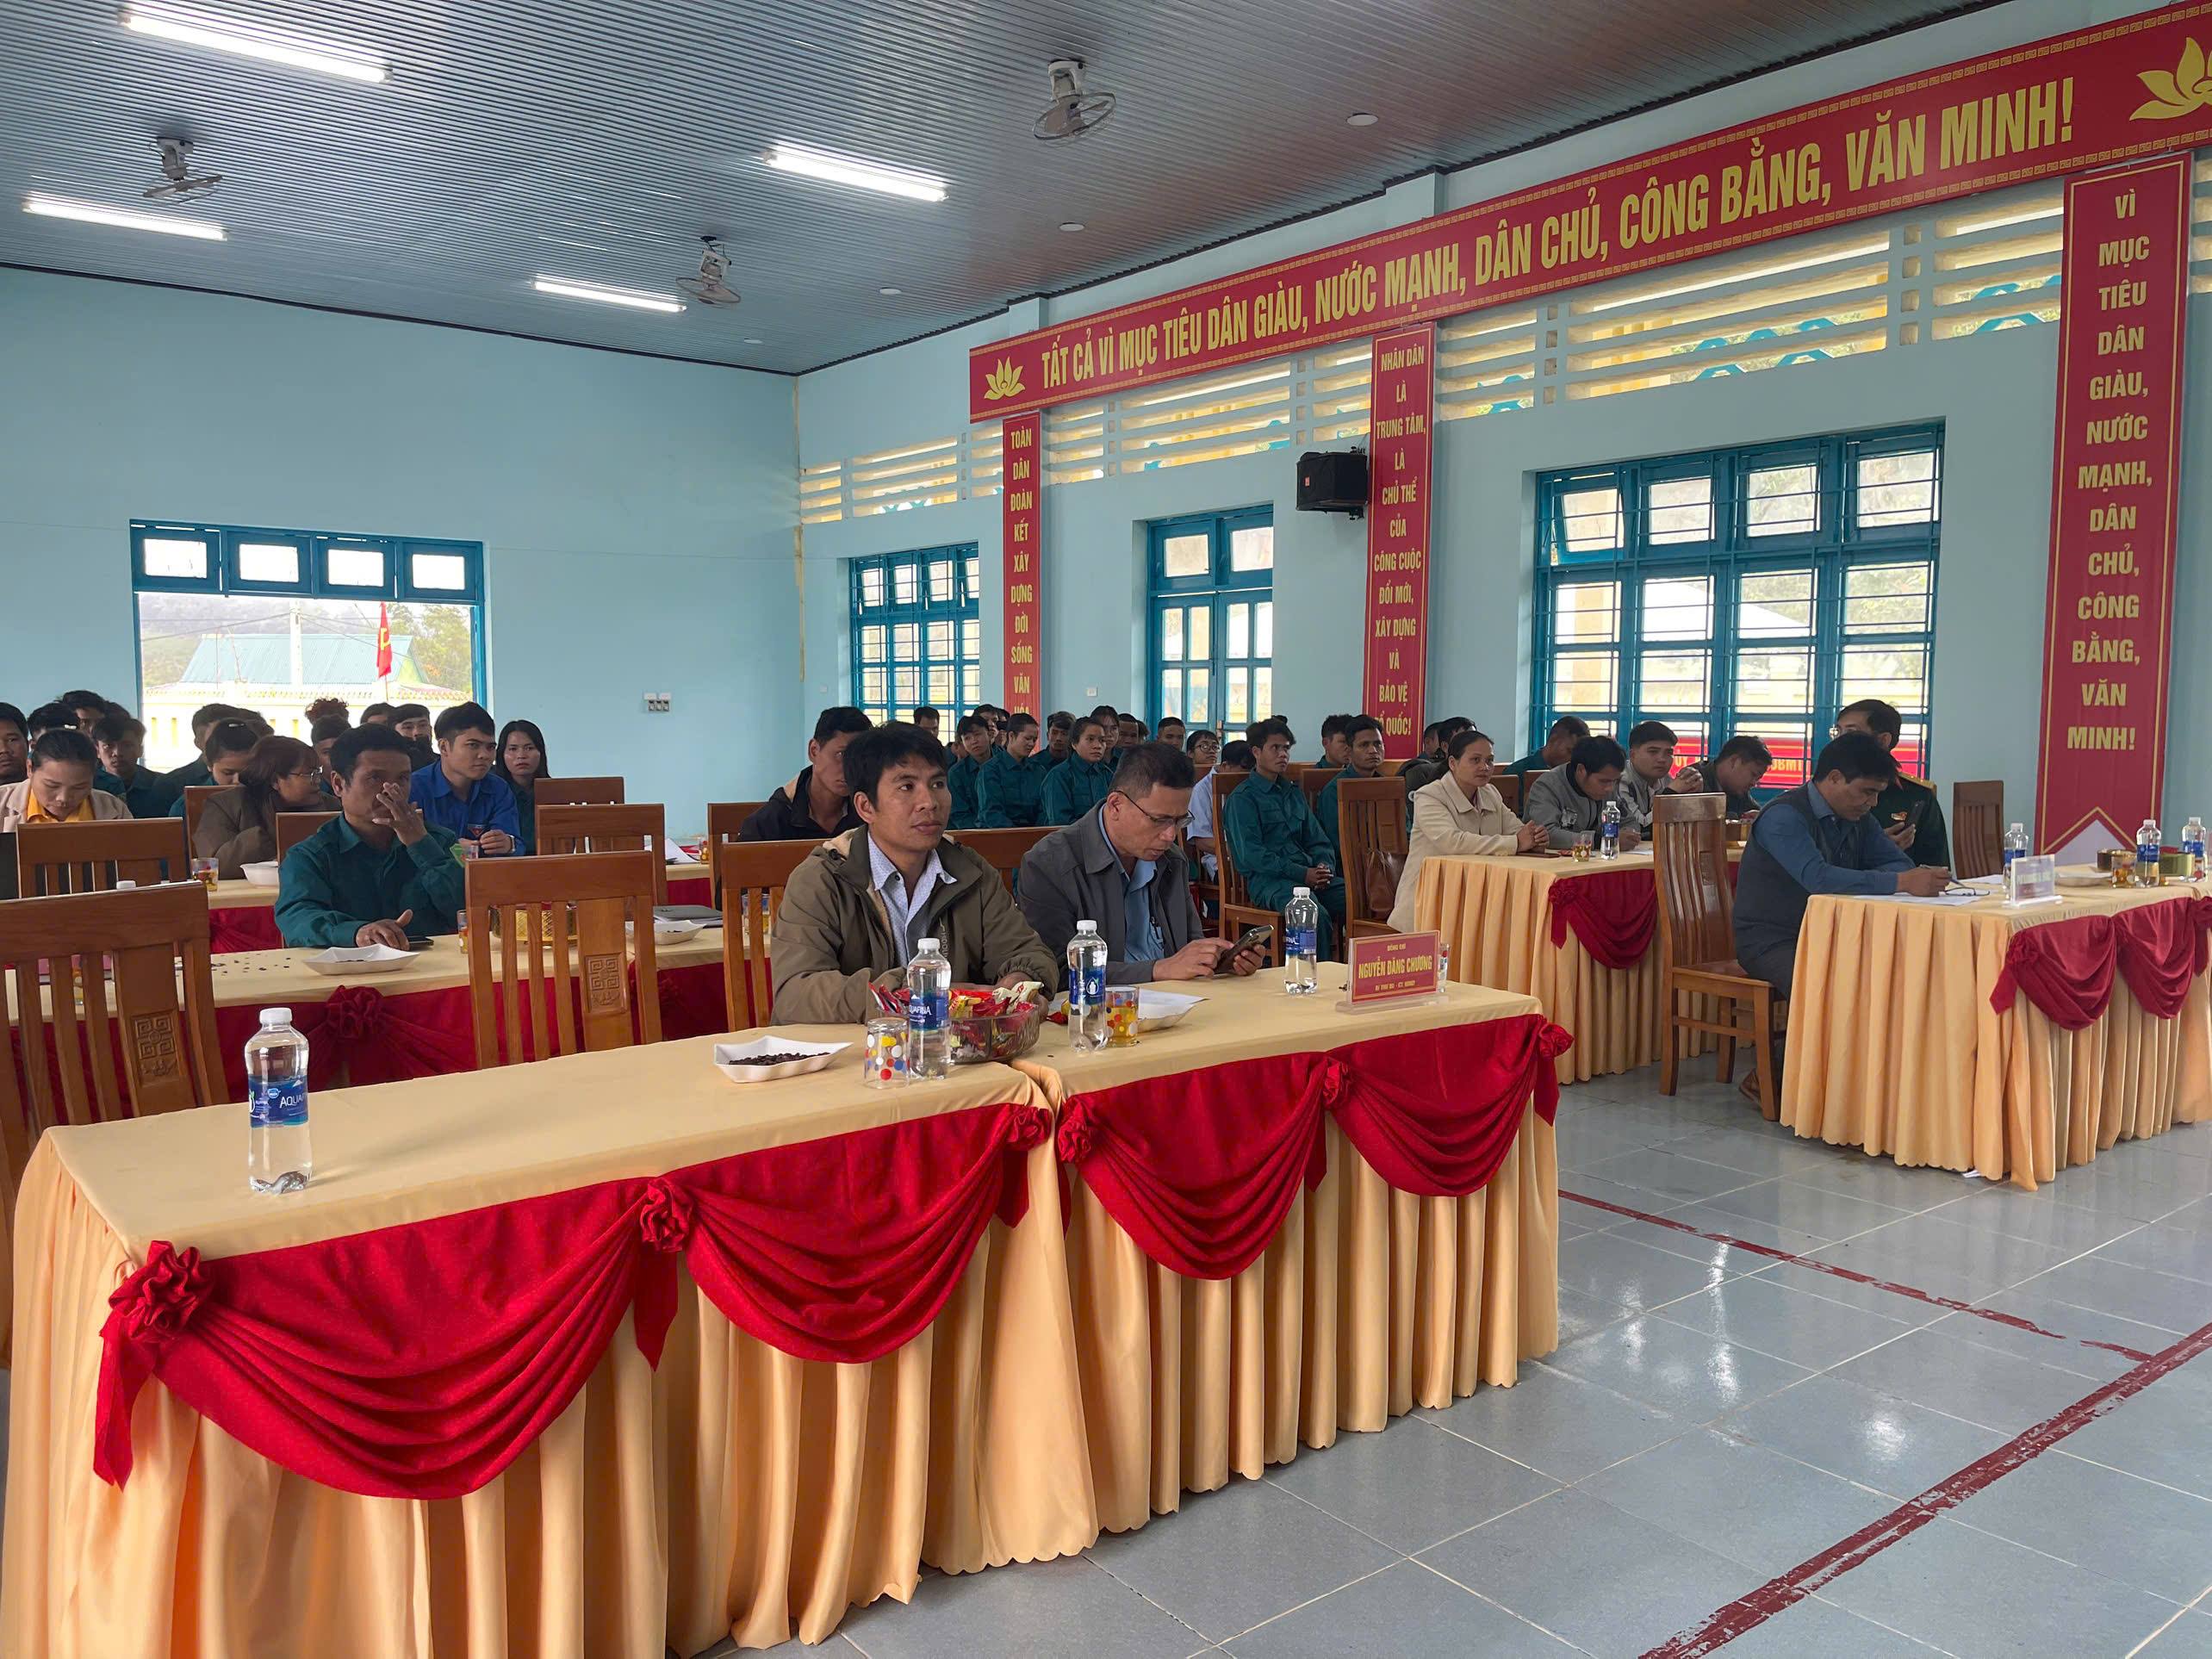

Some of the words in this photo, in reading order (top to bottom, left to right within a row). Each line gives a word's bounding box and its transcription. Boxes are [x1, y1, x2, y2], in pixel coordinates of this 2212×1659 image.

[2114, 188, 2136, 220] VÌ
[1041, 334, 1069, 389] TẤT
[1072, 327, 1095, 382] CẢ
[1098, 326, 1114, 376] VÌ
[1119, 324, 1158, 376] MỤC
[1163, 307, 1202, 361] TIÊU
[1208, 295, 1247, 351] DÂN
[1253, 280, 1308, 339] GIÀU,
[1314, 260, 1377, 325] NƯỚC
[1384, 244, 1466, 312] MẠNH,
[1475, 219, 1532, 286] DÂN
[1540, 186, 1608, 270] CHỦ,
[1619, 174, 1710, 250] CÔNG
[1720, 136, 1831, 225] BẰNG,
[1845, 109, 1927, 192] VĂN
[1939, 76, 2074, 171] MINH!
[2098, 235, 2150, 268] MỤC
[2098, 279, 2147, 311] TIÊU
[2097, 324, 2145, 356] DÂN
[1381, 347, 1404, 372] NHÂN
[1406, 343, 1425, 367] DÂN
[1395, 380, 1407, 403] LÀ
[2089, 369, 2149, 401] GIÀU,
[1010, 428, 1032, 450] TOÀN
[1376, 418, 1403, 439] TRUNG
[1405, 412, 1426, 436] TÂM,
[2085, 413, 2148, 445] NƯỚC
[1013, 459, 1029, 481] DÂN
[1394, 447, 1406, 471] LÀ
[2077, 460, 2153, 493] MẠNH,
[1010, 489, 1033, 512] ĐOÀN
[1382, 479, 1399, 506] CHỦ
[1401, 475, 1418, 502] THỂ
[1014, 517, 1029, 542] KẾT
[1389, 513, 1407, 538] CỦA
[2089, 503, 2137, 532] DÂN
[1013, 554, 1029, 573] XÂY
[1374, 550, 1396, 573] CÔNG
[1399, 547, 1421, 574] CUỘC
[2087, 543, 2141, 577] CHỦ,
[1010, 584, 1033, 607] DỰNG
[1379, 579, 1393, 605] ĐỔI
[1395, 581, 1414, 605] MỚI,
[2077, 591, 2140, 620] CÔNG
[1375, 616, 1391, 637] XÂY
[1393, 617, 1416, 641] DỰNG
[1010, 639, 1033, 664] SỐNG
[1389, 648, 1400, 670] VÀ
[2071, 631, 2141, 666] BẰNG,
[1013, 674, 1030, 694] VĂN
[1379, 679, 1395, 703] BẢO
[1397, 680, 1408, 707] VỆ
[2081, 678, 2127, 706] VĂN
[1386, 711, 1412, 737] QUỐC!
[2066, 726, 2136, 751] MINH!
